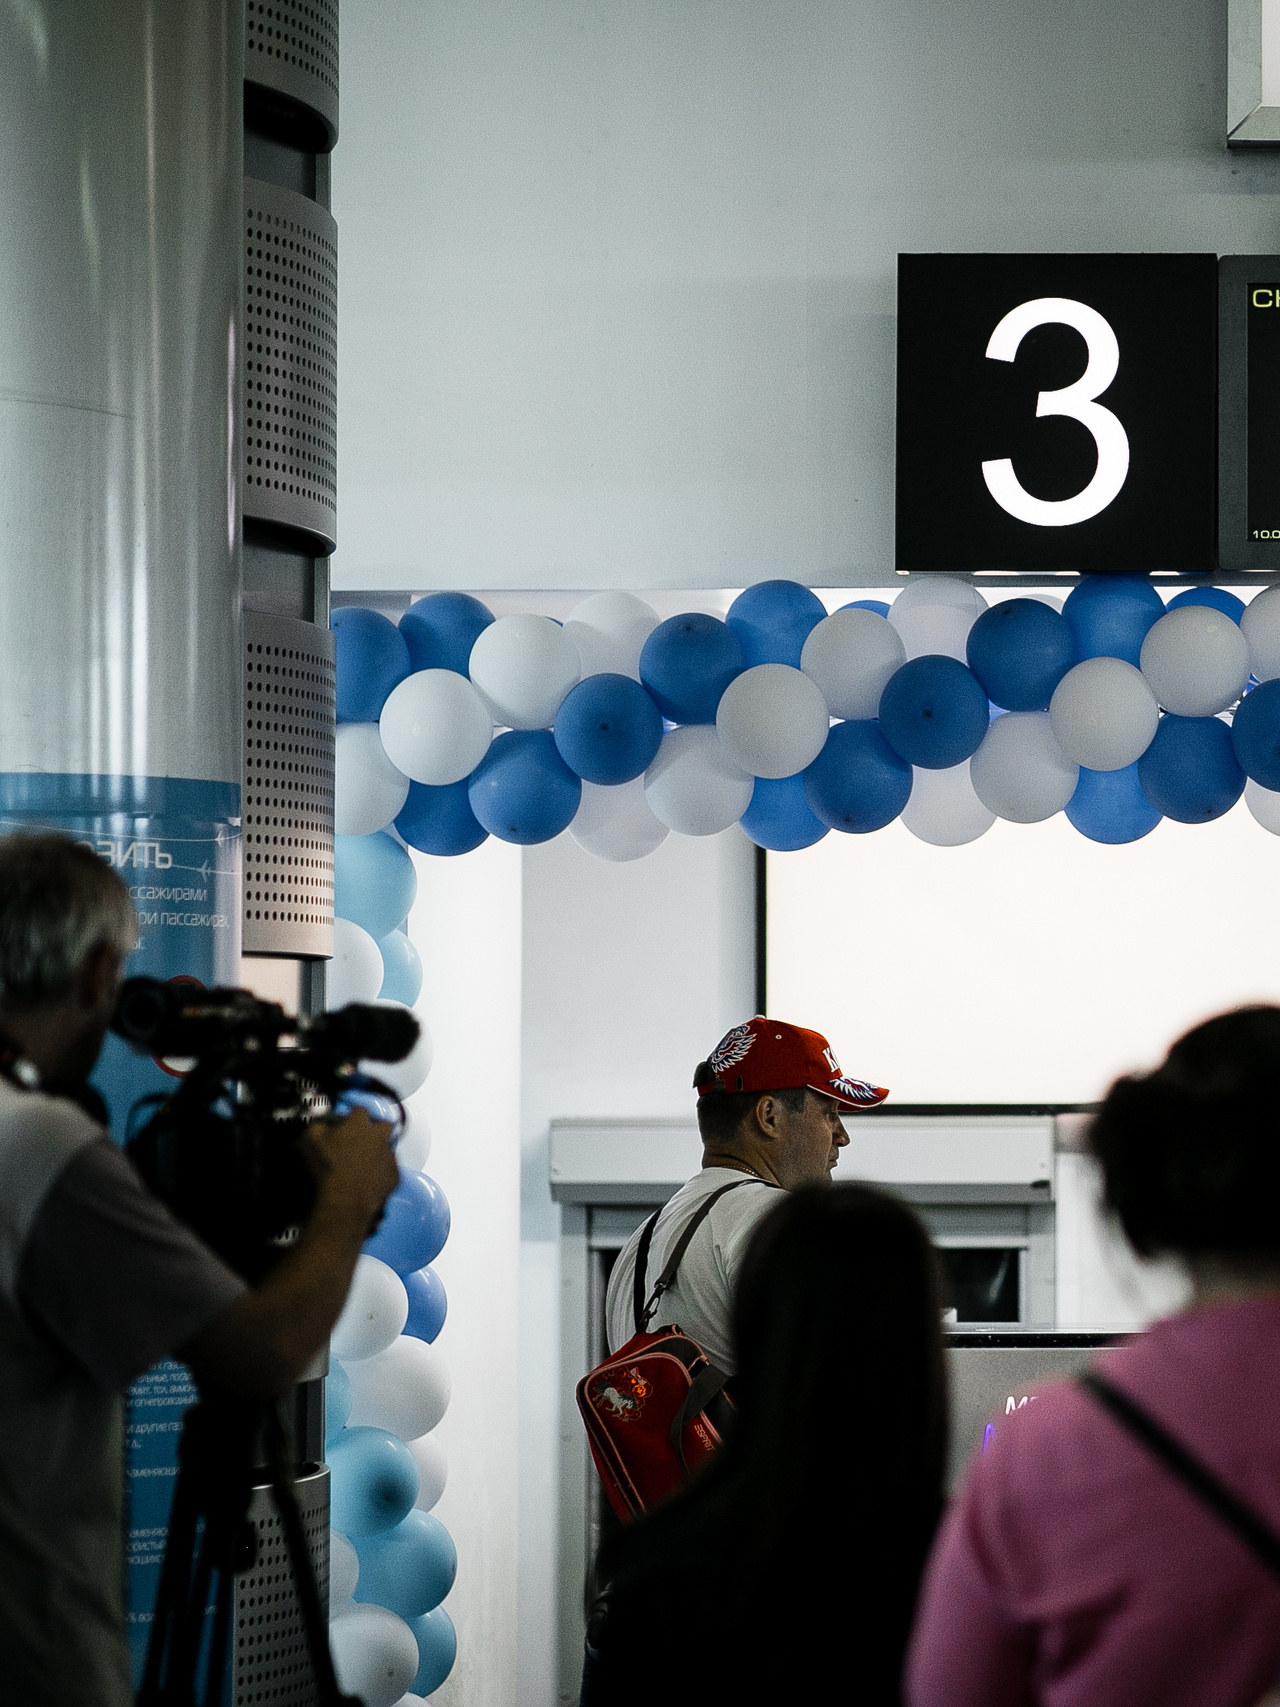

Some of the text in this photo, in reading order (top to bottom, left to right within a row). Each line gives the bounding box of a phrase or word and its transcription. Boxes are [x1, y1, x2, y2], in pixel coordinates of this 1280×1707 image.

[981, 297, 1130, 527] 3
[127, 886, 208, 902] ссажирами
[694, 1423, 716, 1451] ESPRIT
